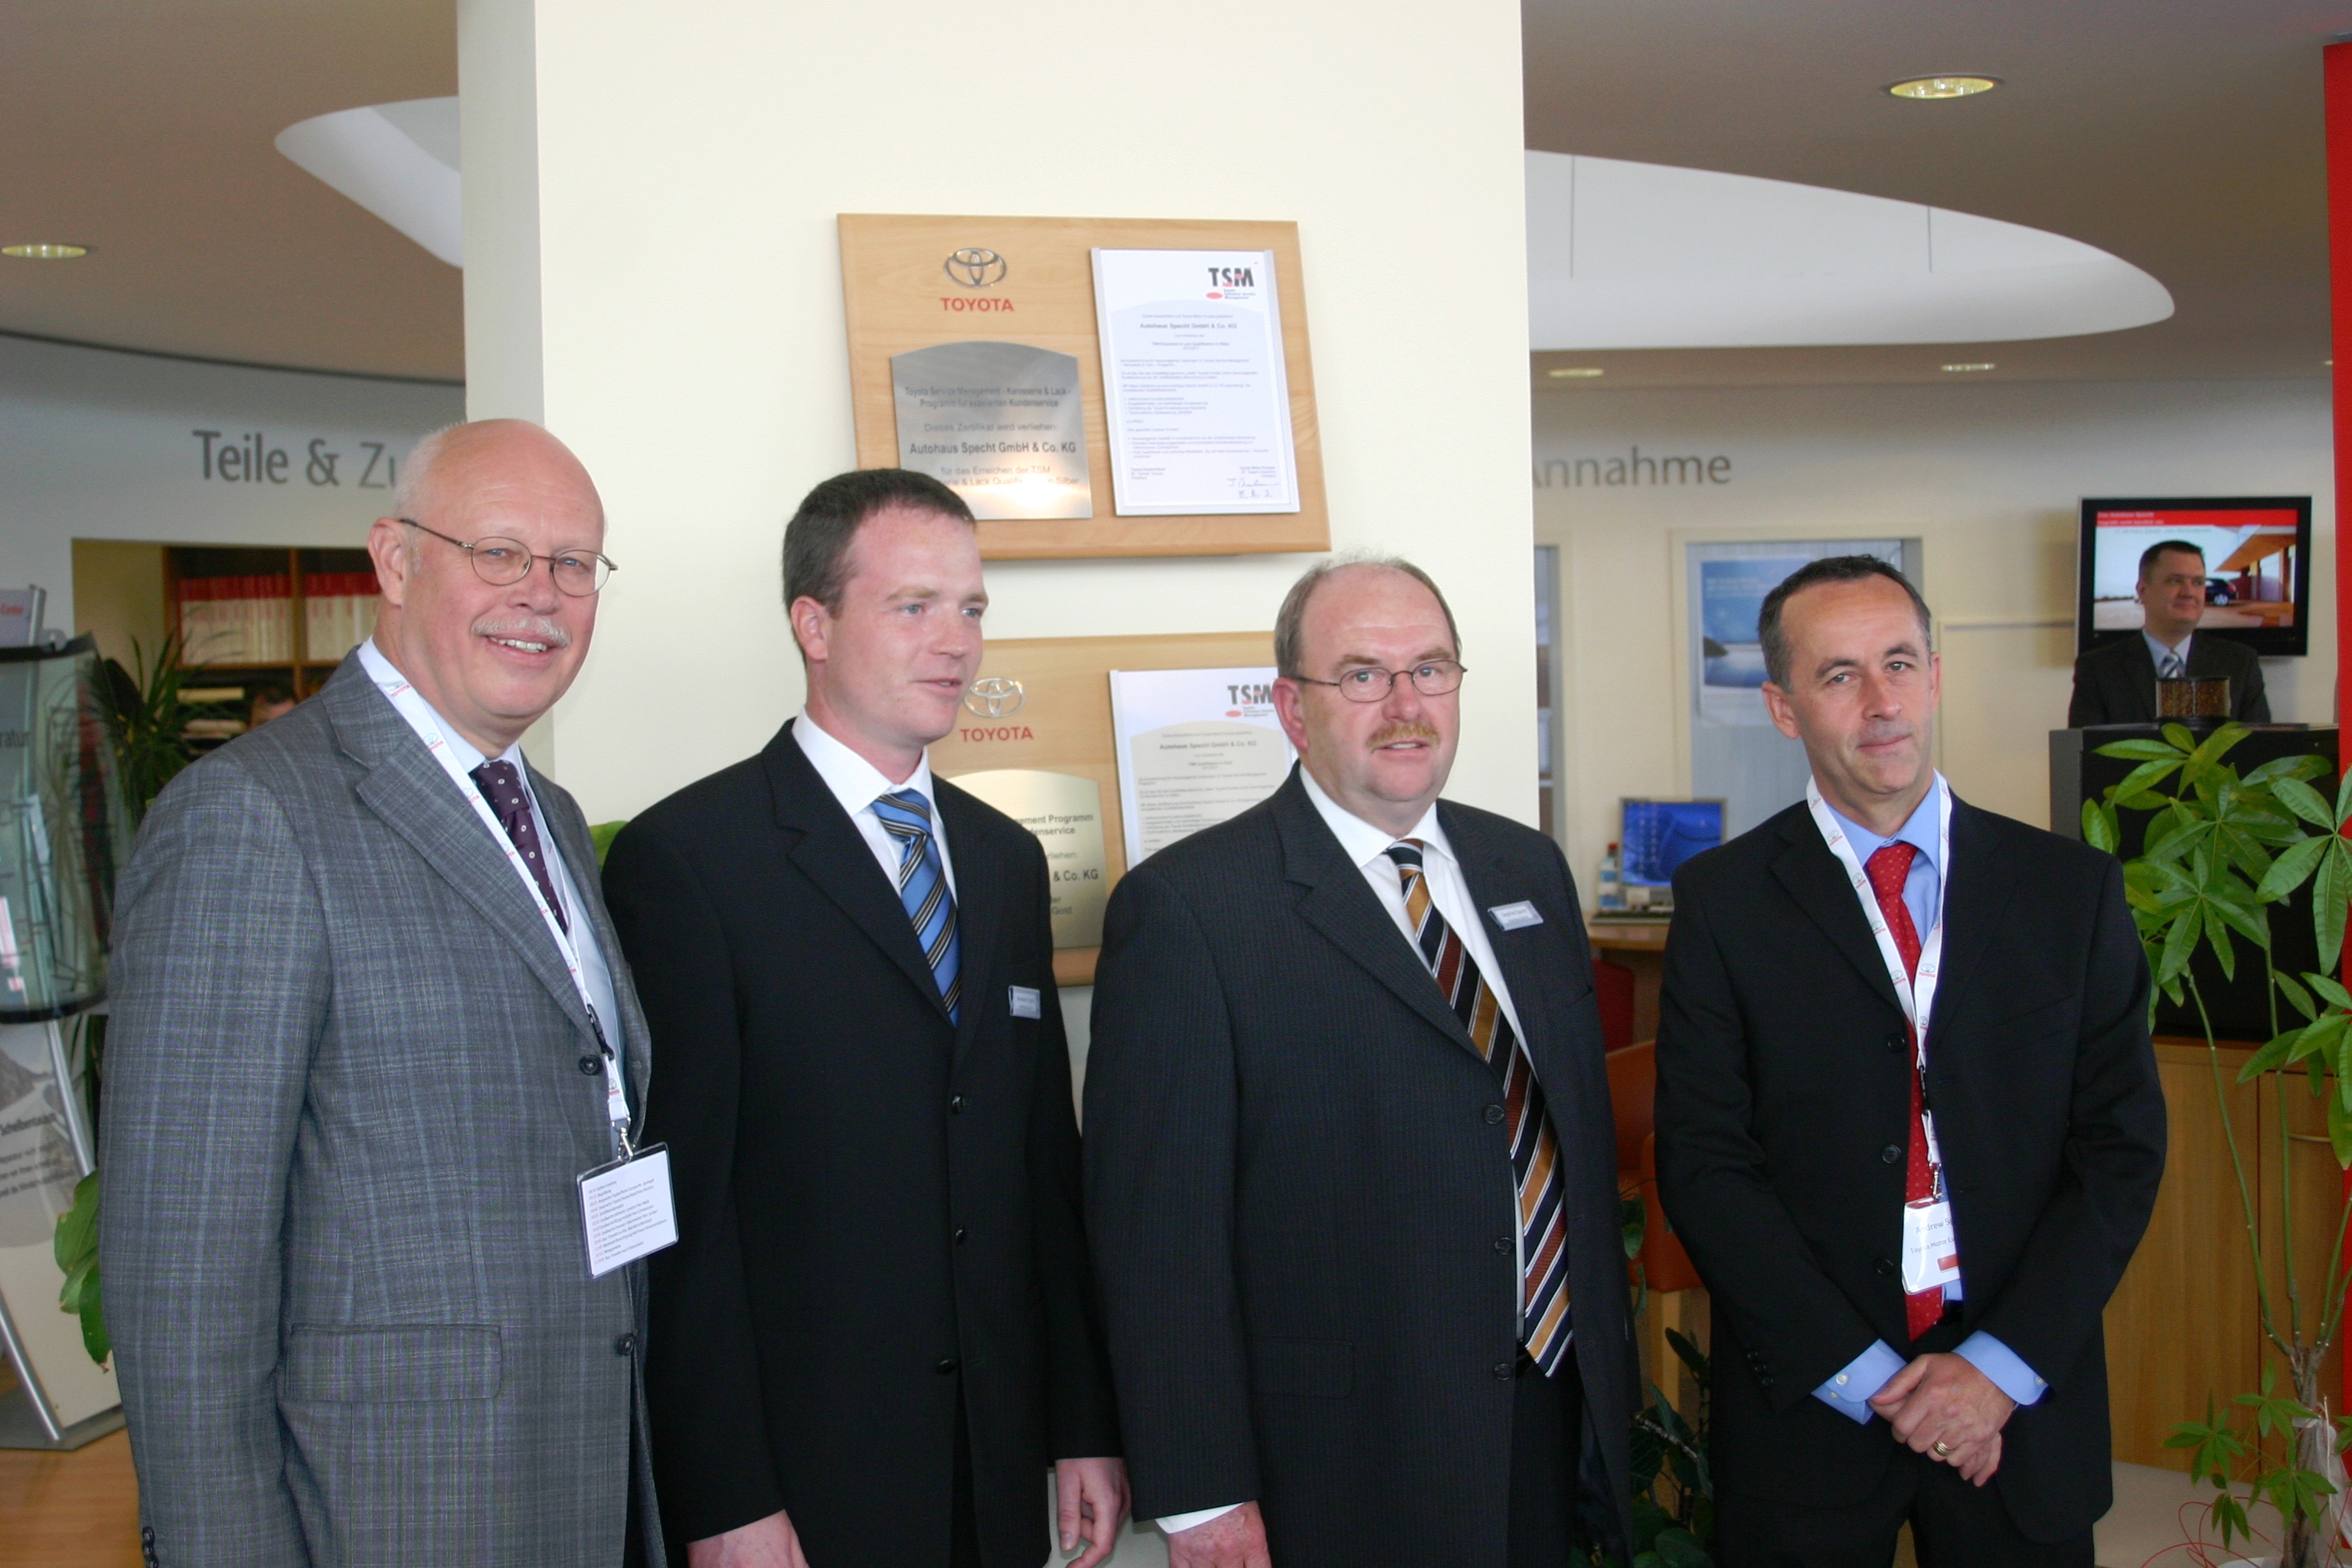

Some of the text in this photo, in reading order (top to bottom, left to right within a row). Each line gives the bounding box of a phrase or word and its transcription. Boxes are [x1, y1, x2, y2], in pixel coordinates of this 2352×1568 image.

[1208, 267, 1255, 287] TSM
[940, 297, 1014, 312] TOYOTA
[910, 441, 1076, 456] Autohaus Specht GmbH & Co. KG
[193, 430, 289, 485] Teile
[307, 438, 339, 487] &
[1031, 465, 1050, 473] TSM
[1227, 684, 1275, 704] TSM
[960, 725, 1034, 743] TOYOTA
[1016, 813, 1093, 825] ement Programm
[1054, 868, 1099, 881] & Co. KG
[1916, 1220, 1944, 1235] Andrew
